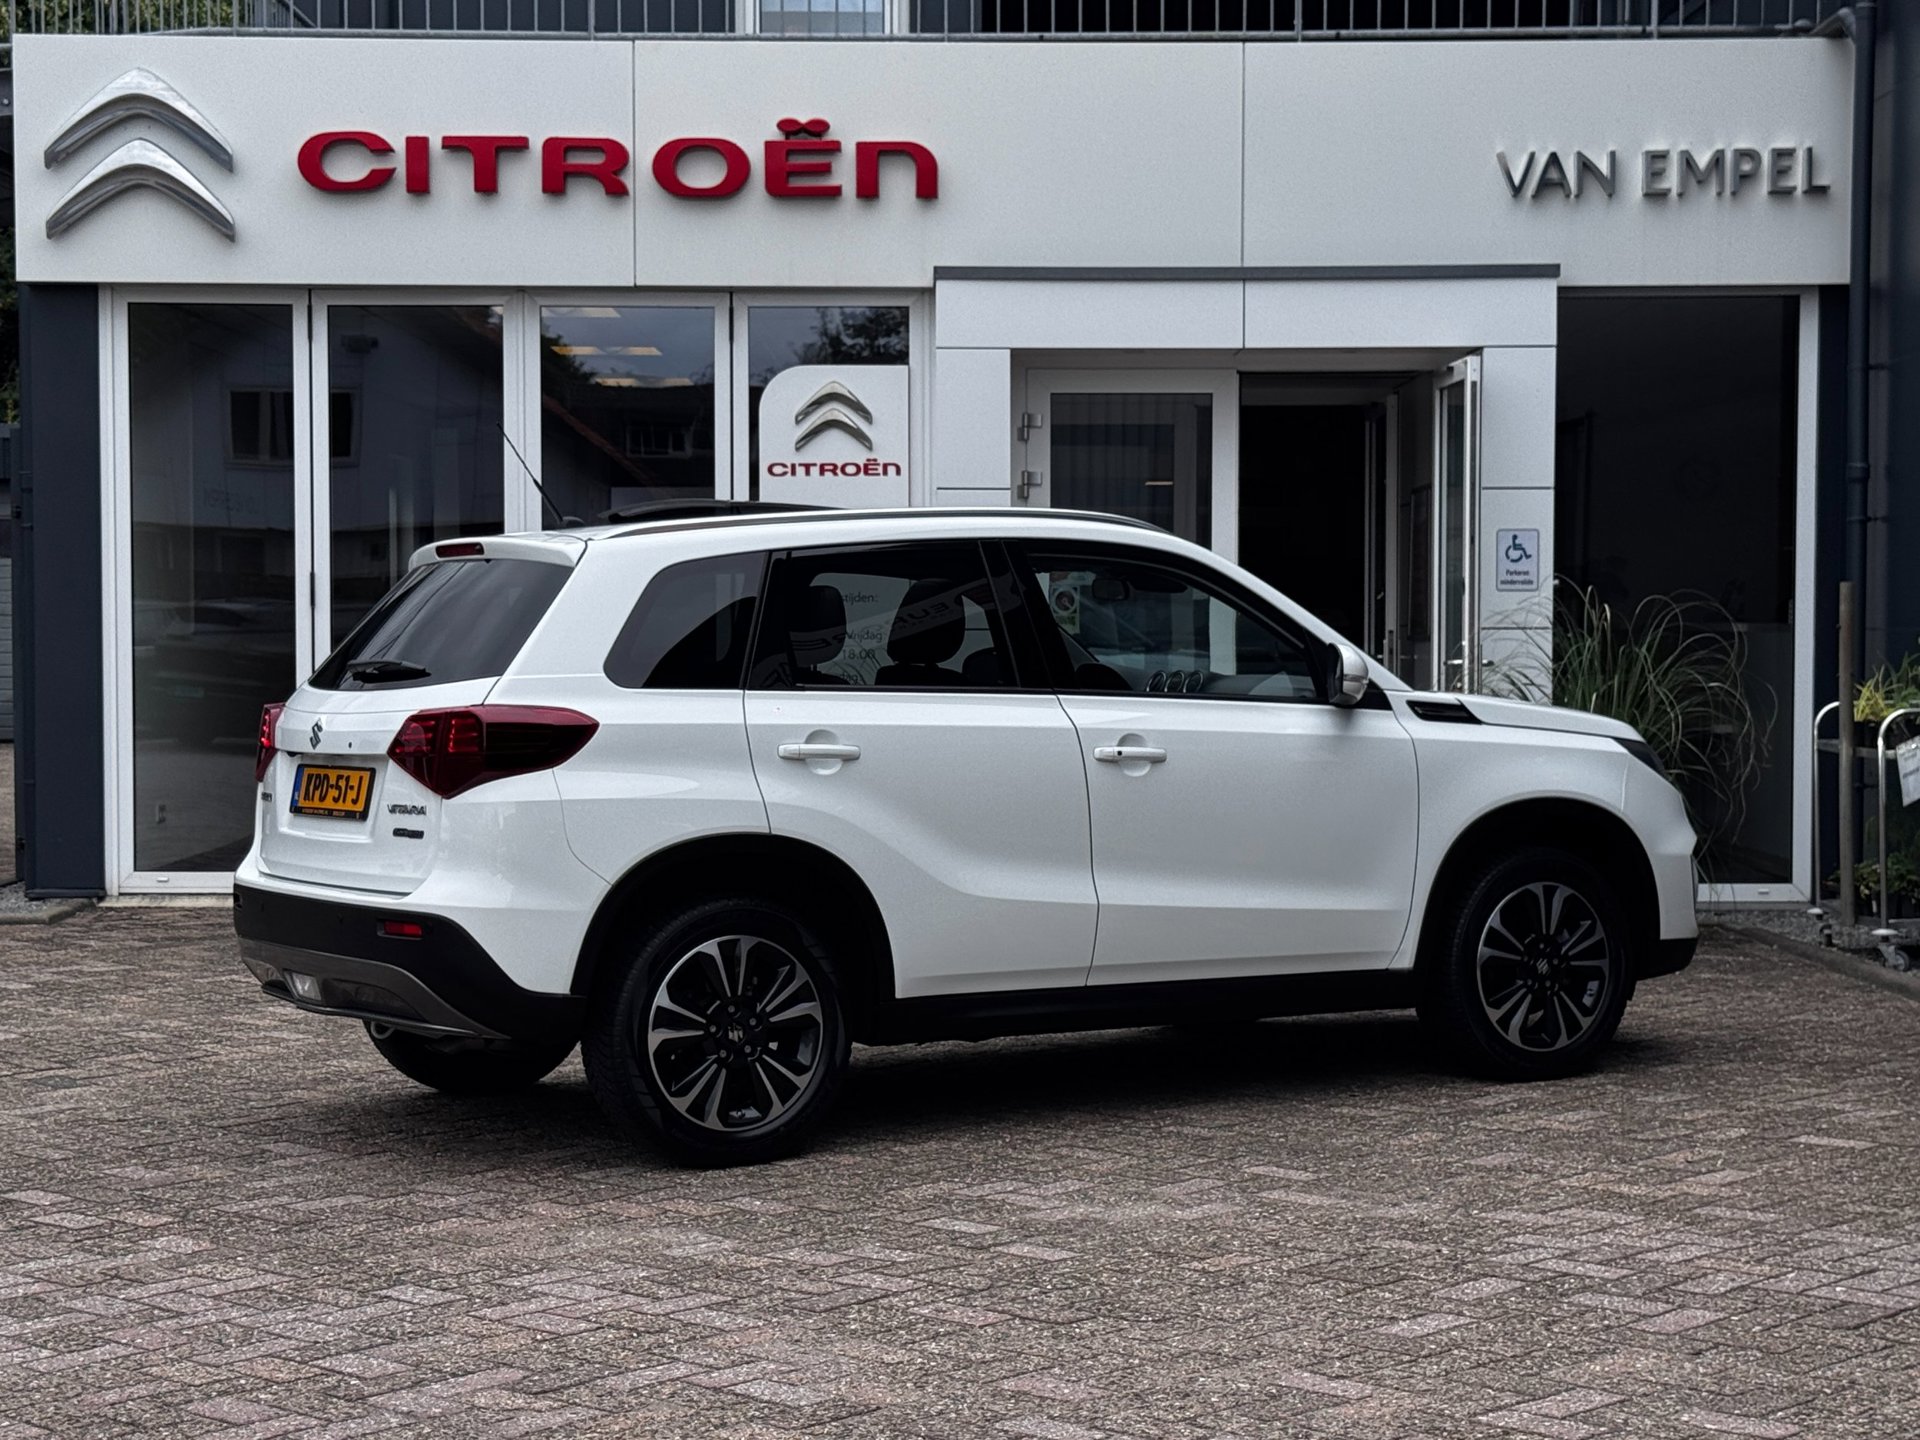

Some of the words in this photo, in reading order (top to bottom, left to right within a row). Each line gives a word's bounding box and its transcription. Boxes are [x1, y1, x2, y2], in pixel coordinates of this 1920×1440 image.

[1496, 149, 1616, 198] VAN
[1641, 146, 1831, 197] EMPEL
[303, 772, 363, 806] KPD-51-J
